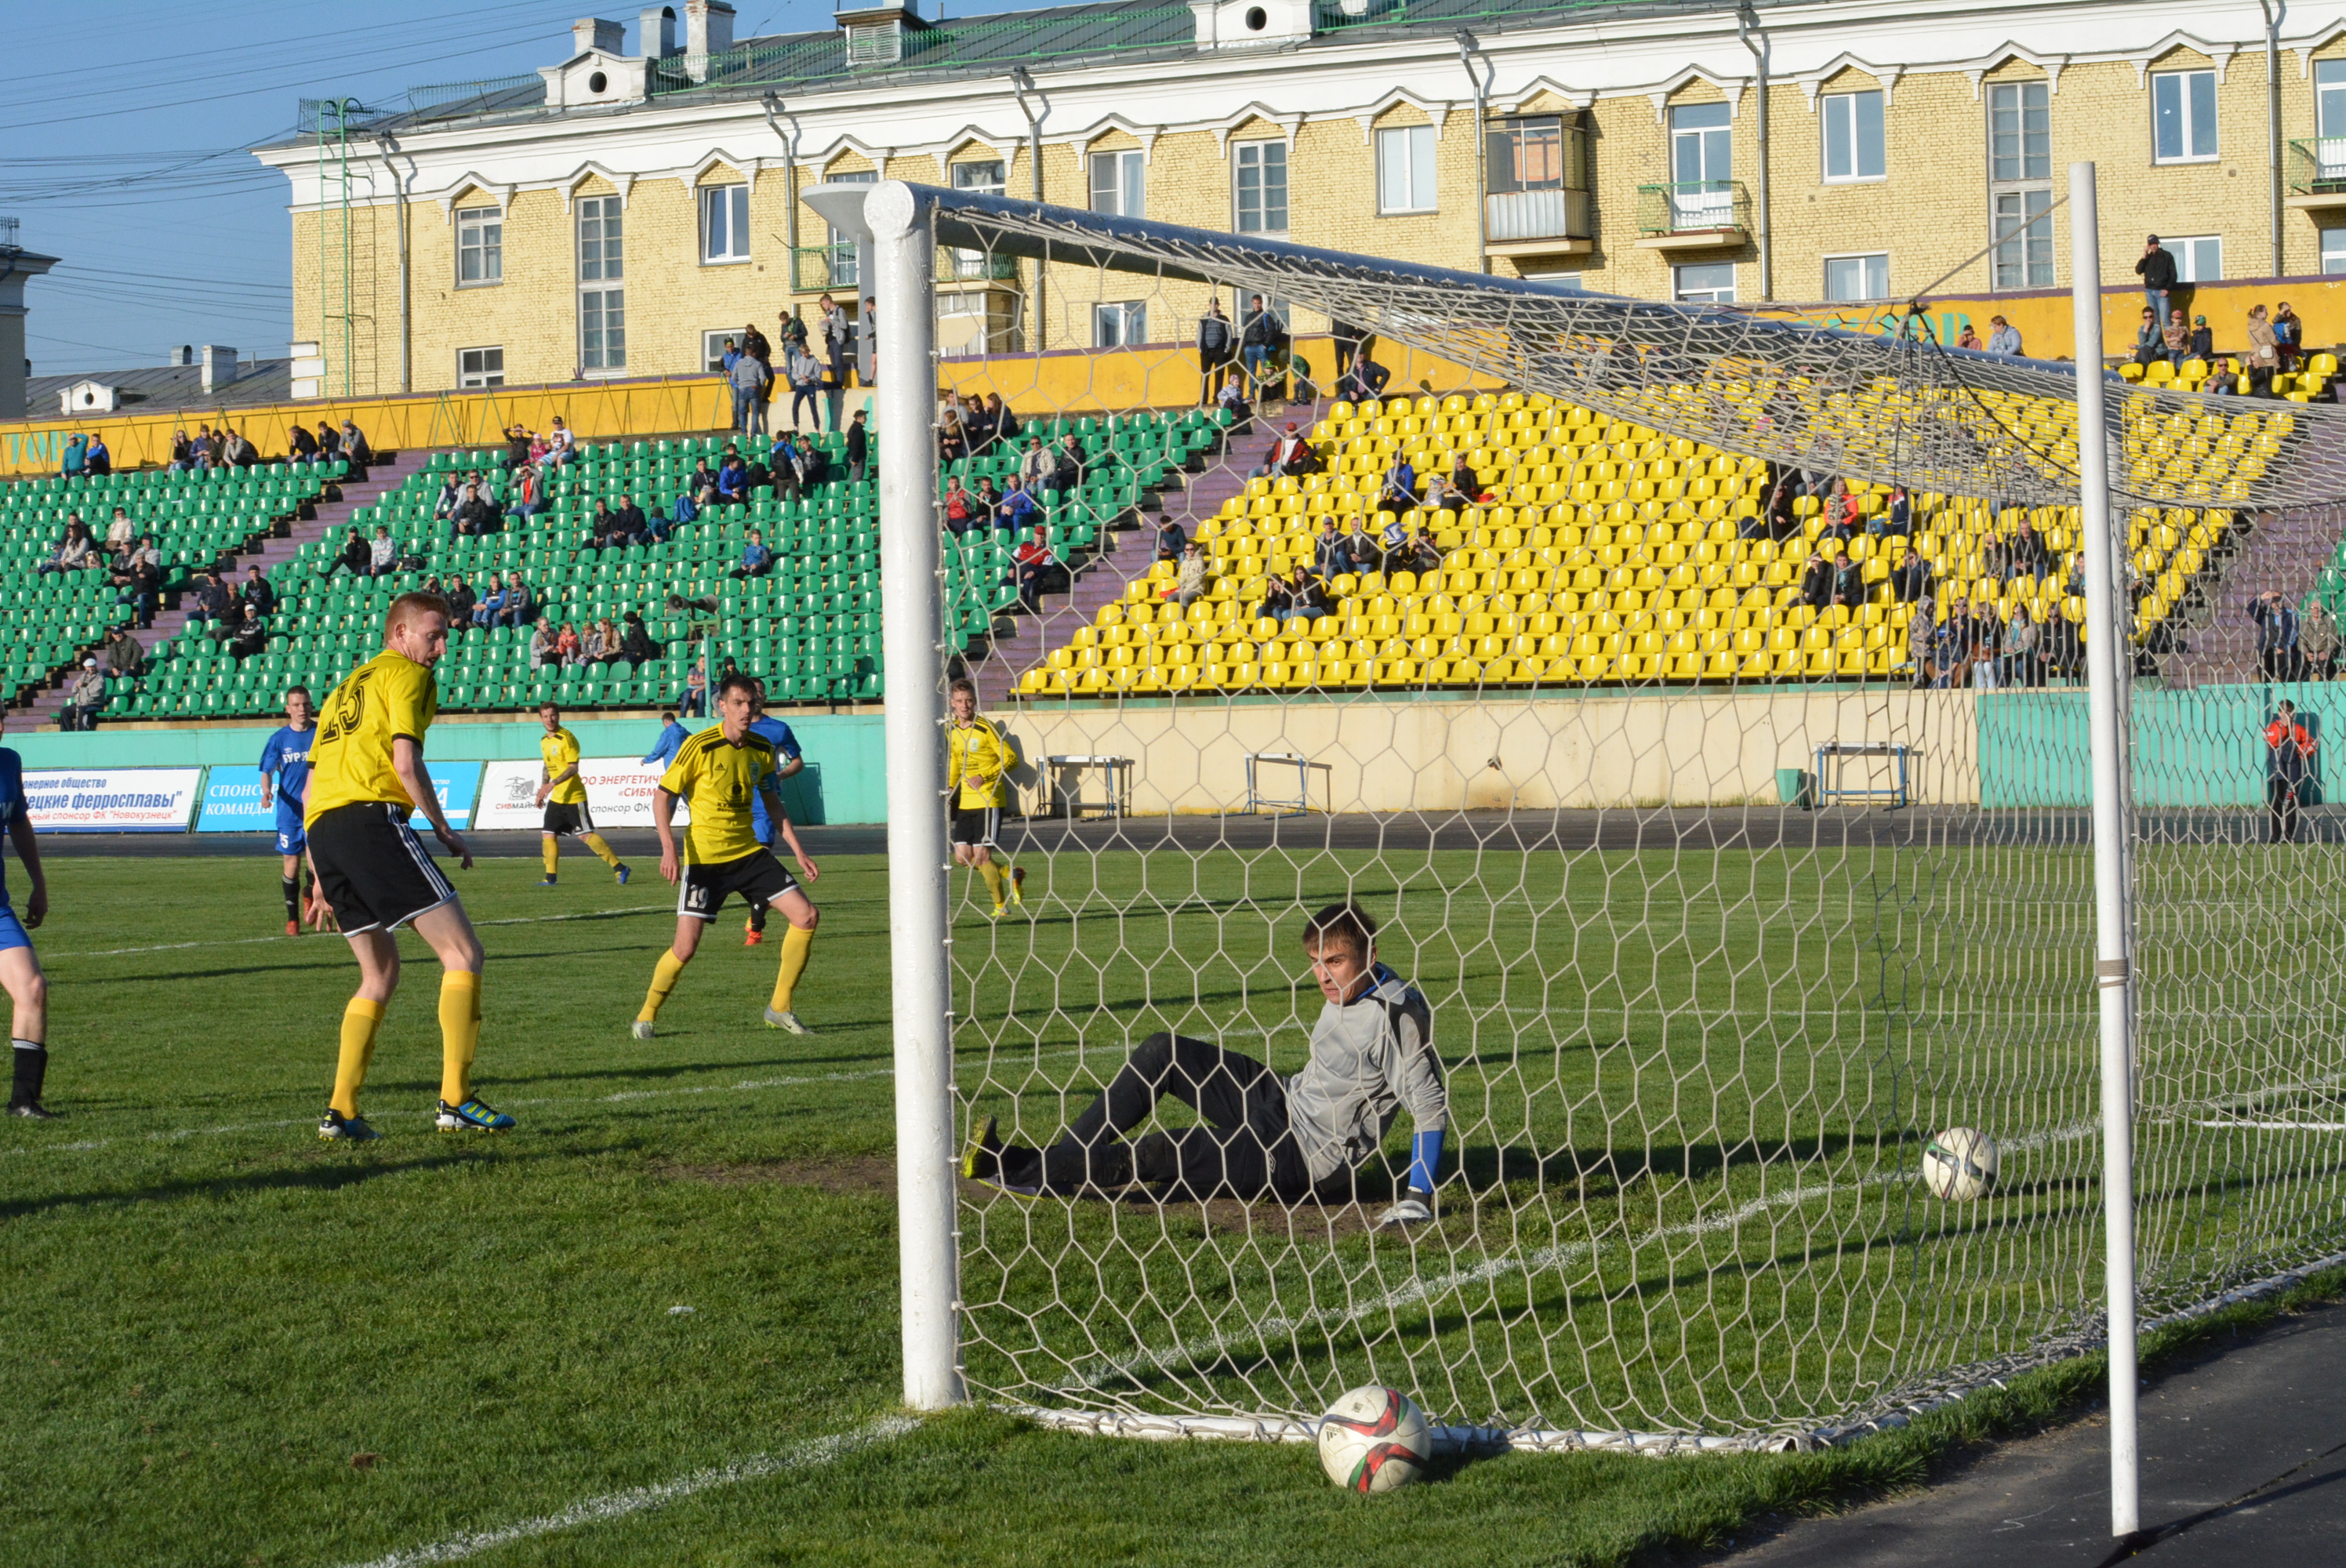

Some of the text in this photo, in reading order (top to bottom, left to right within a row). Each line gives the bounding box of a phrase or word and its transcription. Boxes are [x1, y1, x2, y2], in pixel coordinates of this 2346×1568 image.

[320, 666, 377, 746] 15
[282, 751, 310, 764] БУРЯ
[23, 778, 107, 789] онерное общество
[599, 775, 664, 785] ЭНЕРГЕТИЧ
[26, 794, 69, 811] ецкие
[71, 790, 182, 810] ферросплавы"
[590, 803, 650, 814] спонсор ФК
[27, 810, 177, 822] ьный спонсор ФК "Новокузнецк"
[688, 884, 709, 909] 19
